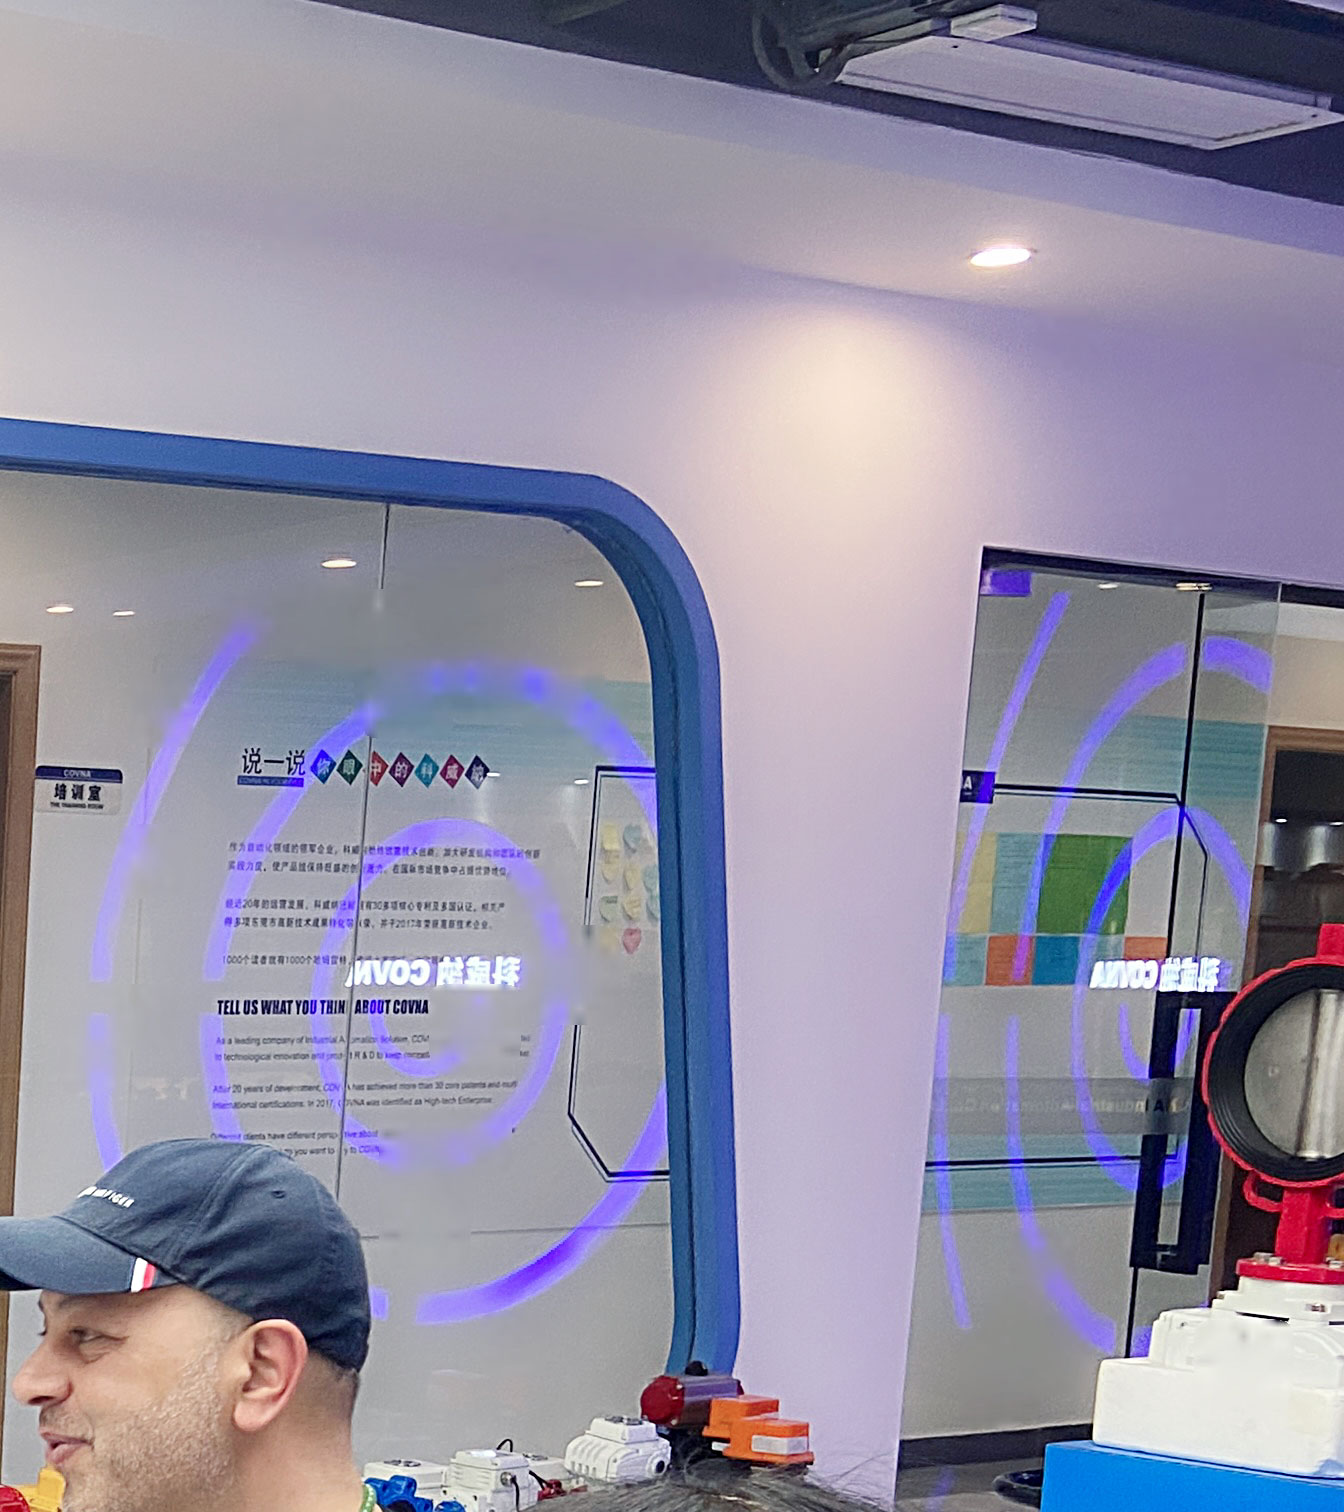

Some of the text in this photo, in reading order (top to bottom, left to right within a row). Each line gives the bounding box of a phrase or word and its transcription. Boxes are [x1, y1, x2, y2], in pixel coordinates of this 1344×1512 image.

[242, 747, 306, 776] 说一说
[63, 768, 92, 779] COVNA
[54, 783, 102, 801] 培训室
[217, 999, 429, 1015] TELL US WHAT YOU THIN ABOUT COVNA
